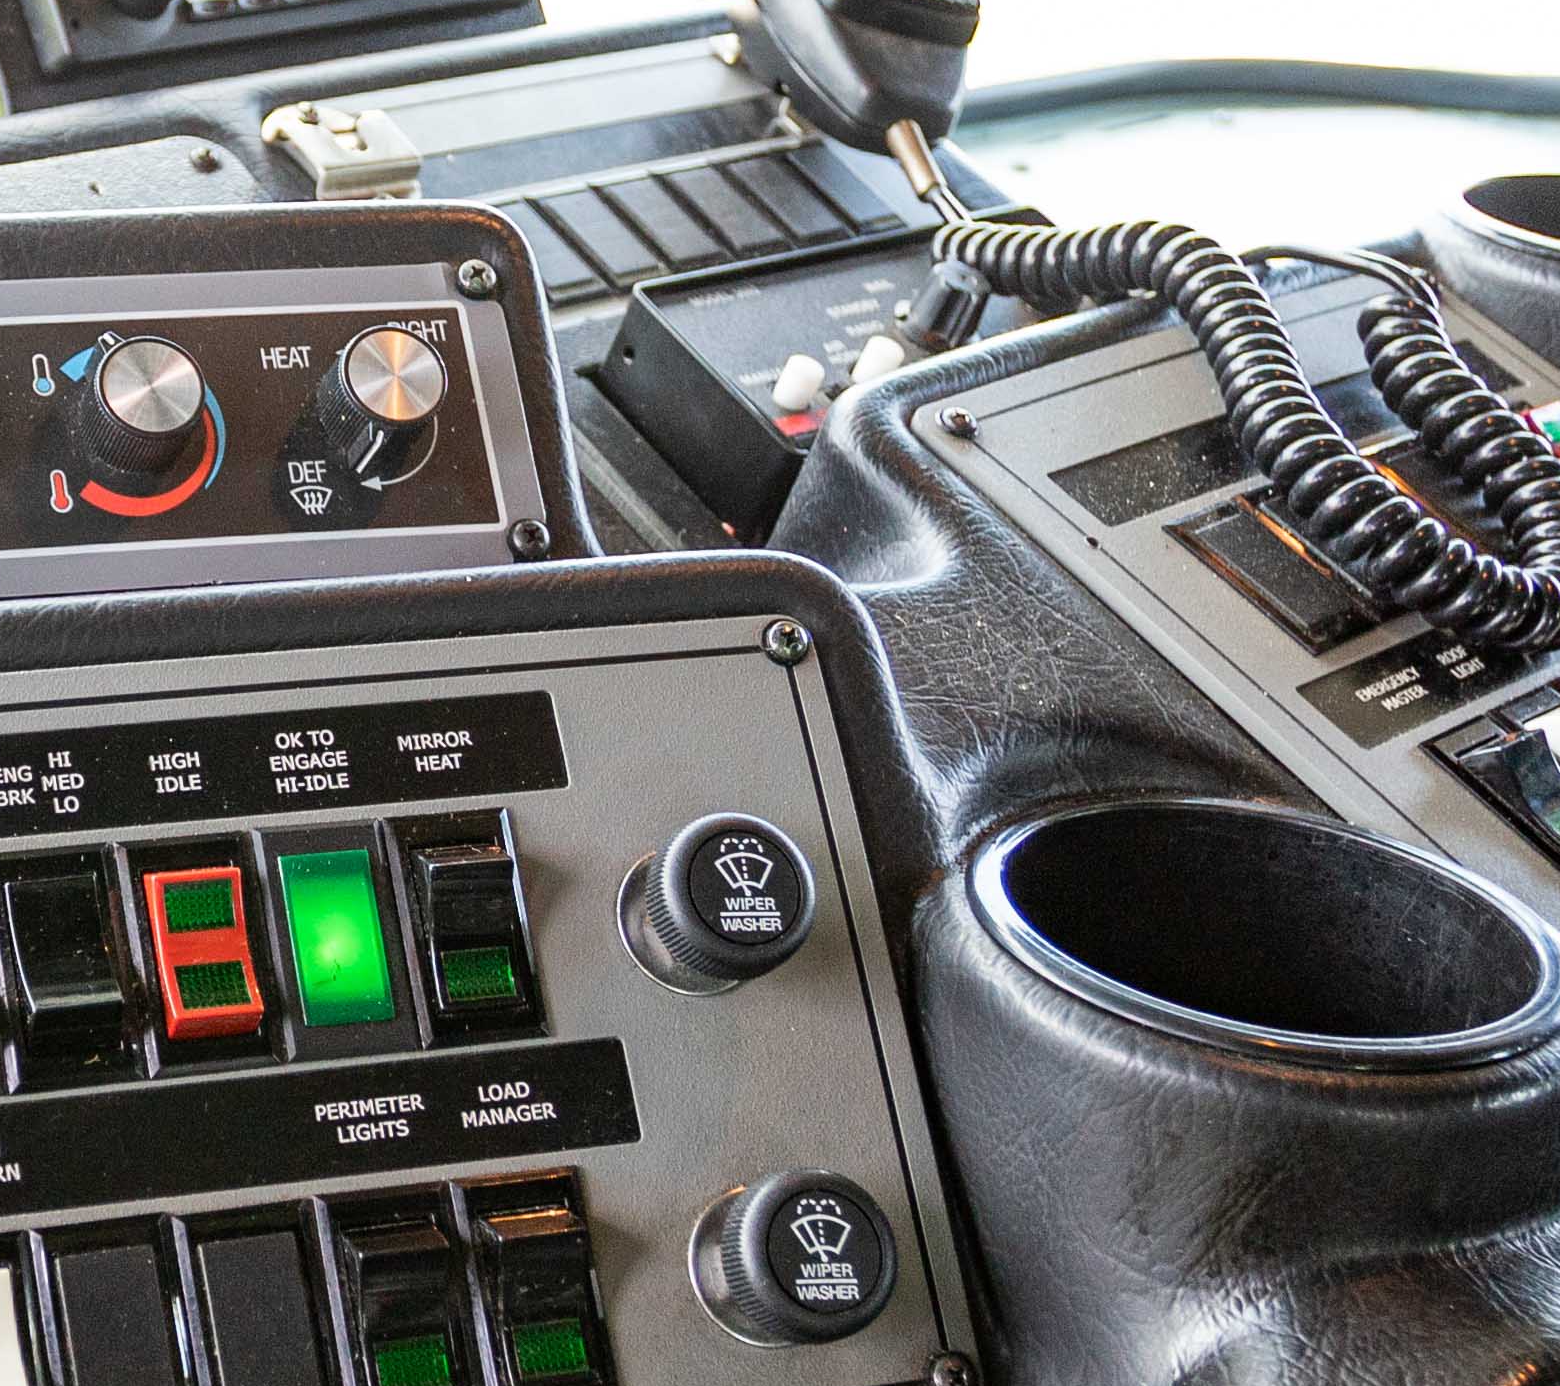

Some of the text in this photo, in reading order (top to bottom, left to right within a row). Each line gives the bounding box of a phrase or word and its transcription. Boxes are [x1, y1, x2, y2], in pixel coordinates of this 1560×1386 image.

[260, 345, 311, 370] HEAT
[288, 460, 327, 485] DEF
[1435, 645, 1468, 666] ROOF
[1450, 657, 1485, 680] LIGHT
[1355, 666, 1421, 703] EMERGENCY
[1380, 684, 1429, 712] MASTER
[275, 729, 335, 750] OK TO
[396, 731, 473, 753] MIRROR
[47, 751, 72, 769] HI
[149, 751, 201, 773] HIGH
[269, 750, 349, 773] ENGAGE
[414, 753, 463, 773] HEAT
[40, 773, 85, 793] MED
[155, 774, 202, 794] IDLE
[275, 772, 350, 794] HI-IDLE
[53, 796, 79, 814] LO
[724, 897, 776, 911] WIPER
[720, 917, 783, 932] WASHER
[478, 1082, 530, 1103] LOAD
[314, 1094, 425, 1123] PERIMETER
[460, 1103, 556, 1129] MANAGER
[337, 1119, 409, 1145] LIGHTS
[800, 1263, 853, 1278] WIPER
[796, 1285, 860, 1300] WASHER
